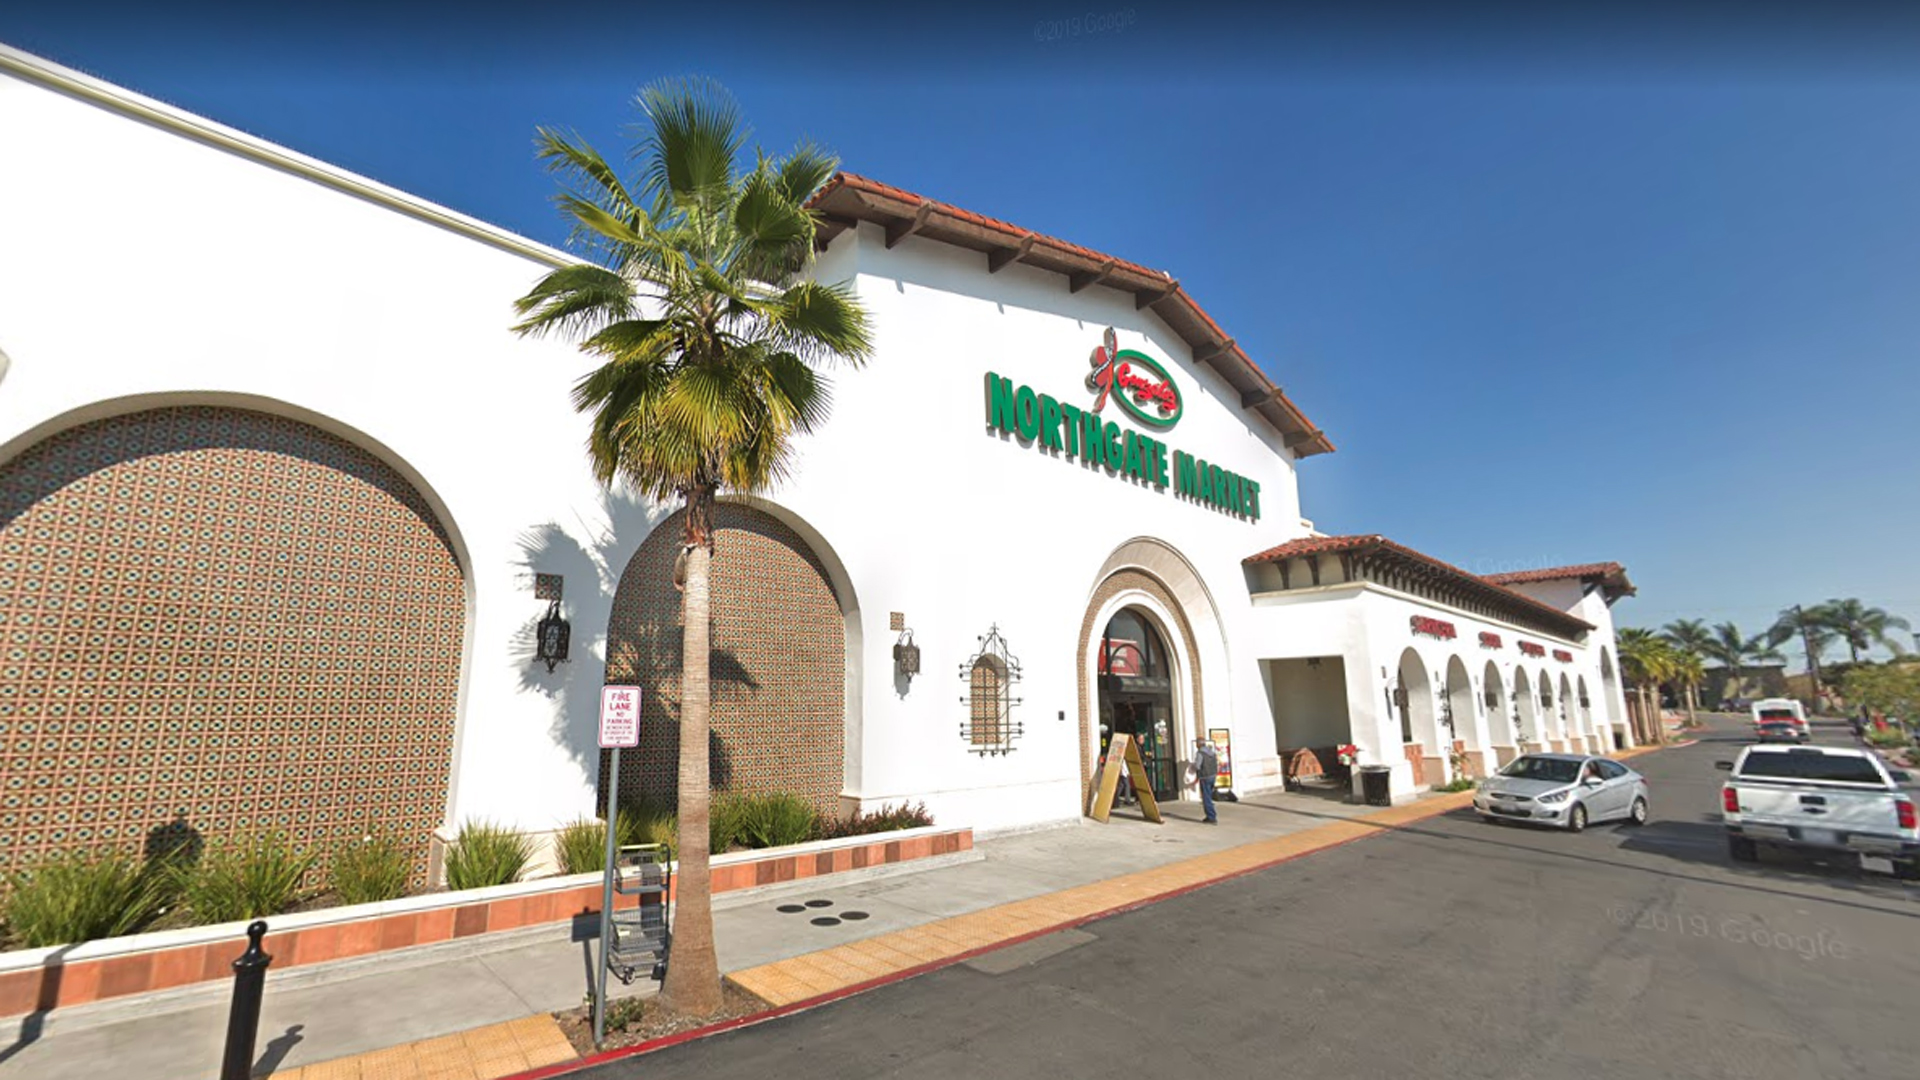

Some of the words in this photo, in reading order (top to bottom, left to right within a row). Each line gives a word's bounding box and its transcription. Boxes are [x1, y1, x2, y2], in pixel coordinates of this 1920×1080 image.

[985, 371, 1170, 490] NORTHGATE
[1173, 450, 1261, 521] MARKET
[611, 692, 631, 701] FIRE
[609, 703, 632, 711] LANE
